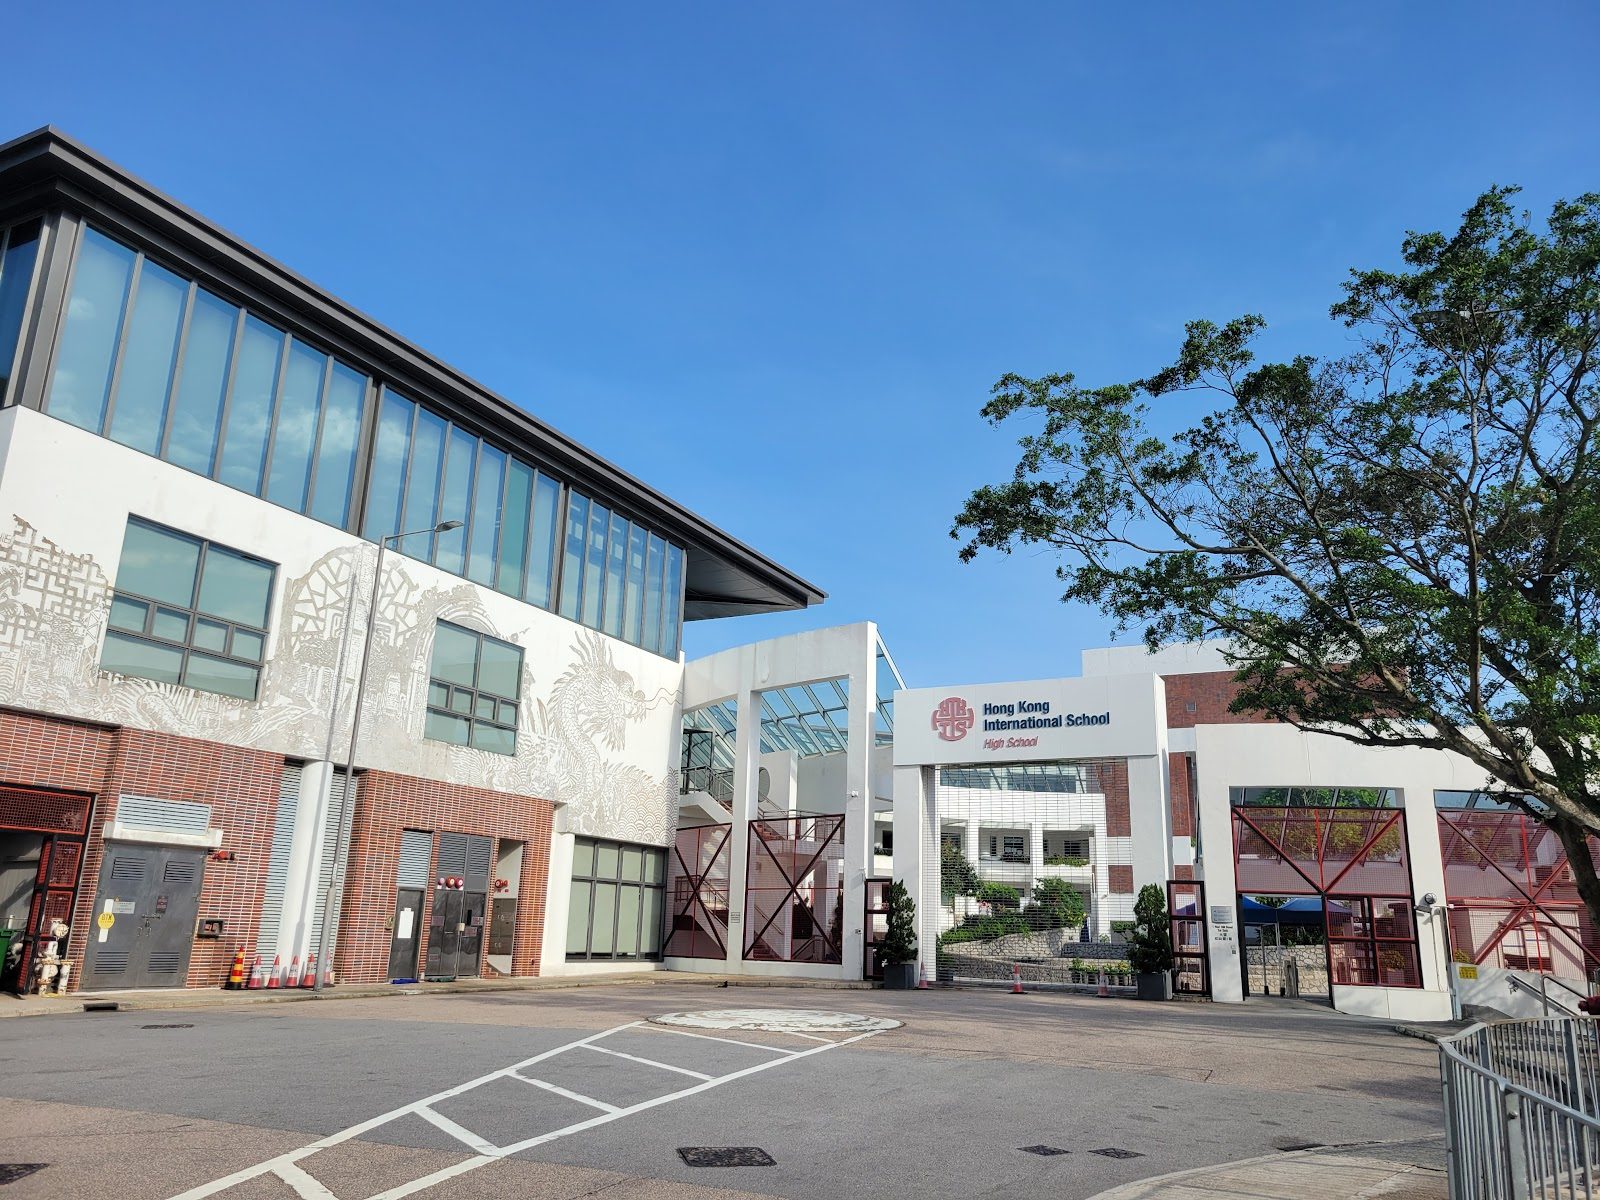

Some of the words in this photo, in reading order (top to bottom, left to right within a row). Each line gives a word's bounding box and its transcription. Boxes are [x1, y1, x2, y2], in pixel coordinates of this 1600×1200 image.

[983, 703, 1014, 716] Hong
[1018, 701, 1050, 715] Kong
[983, 714, 1062, 731] International
[1066, 712, 1110, 727] School
[983, 738, 1004, 751] High
[1006, 736, 1039, 748] School
